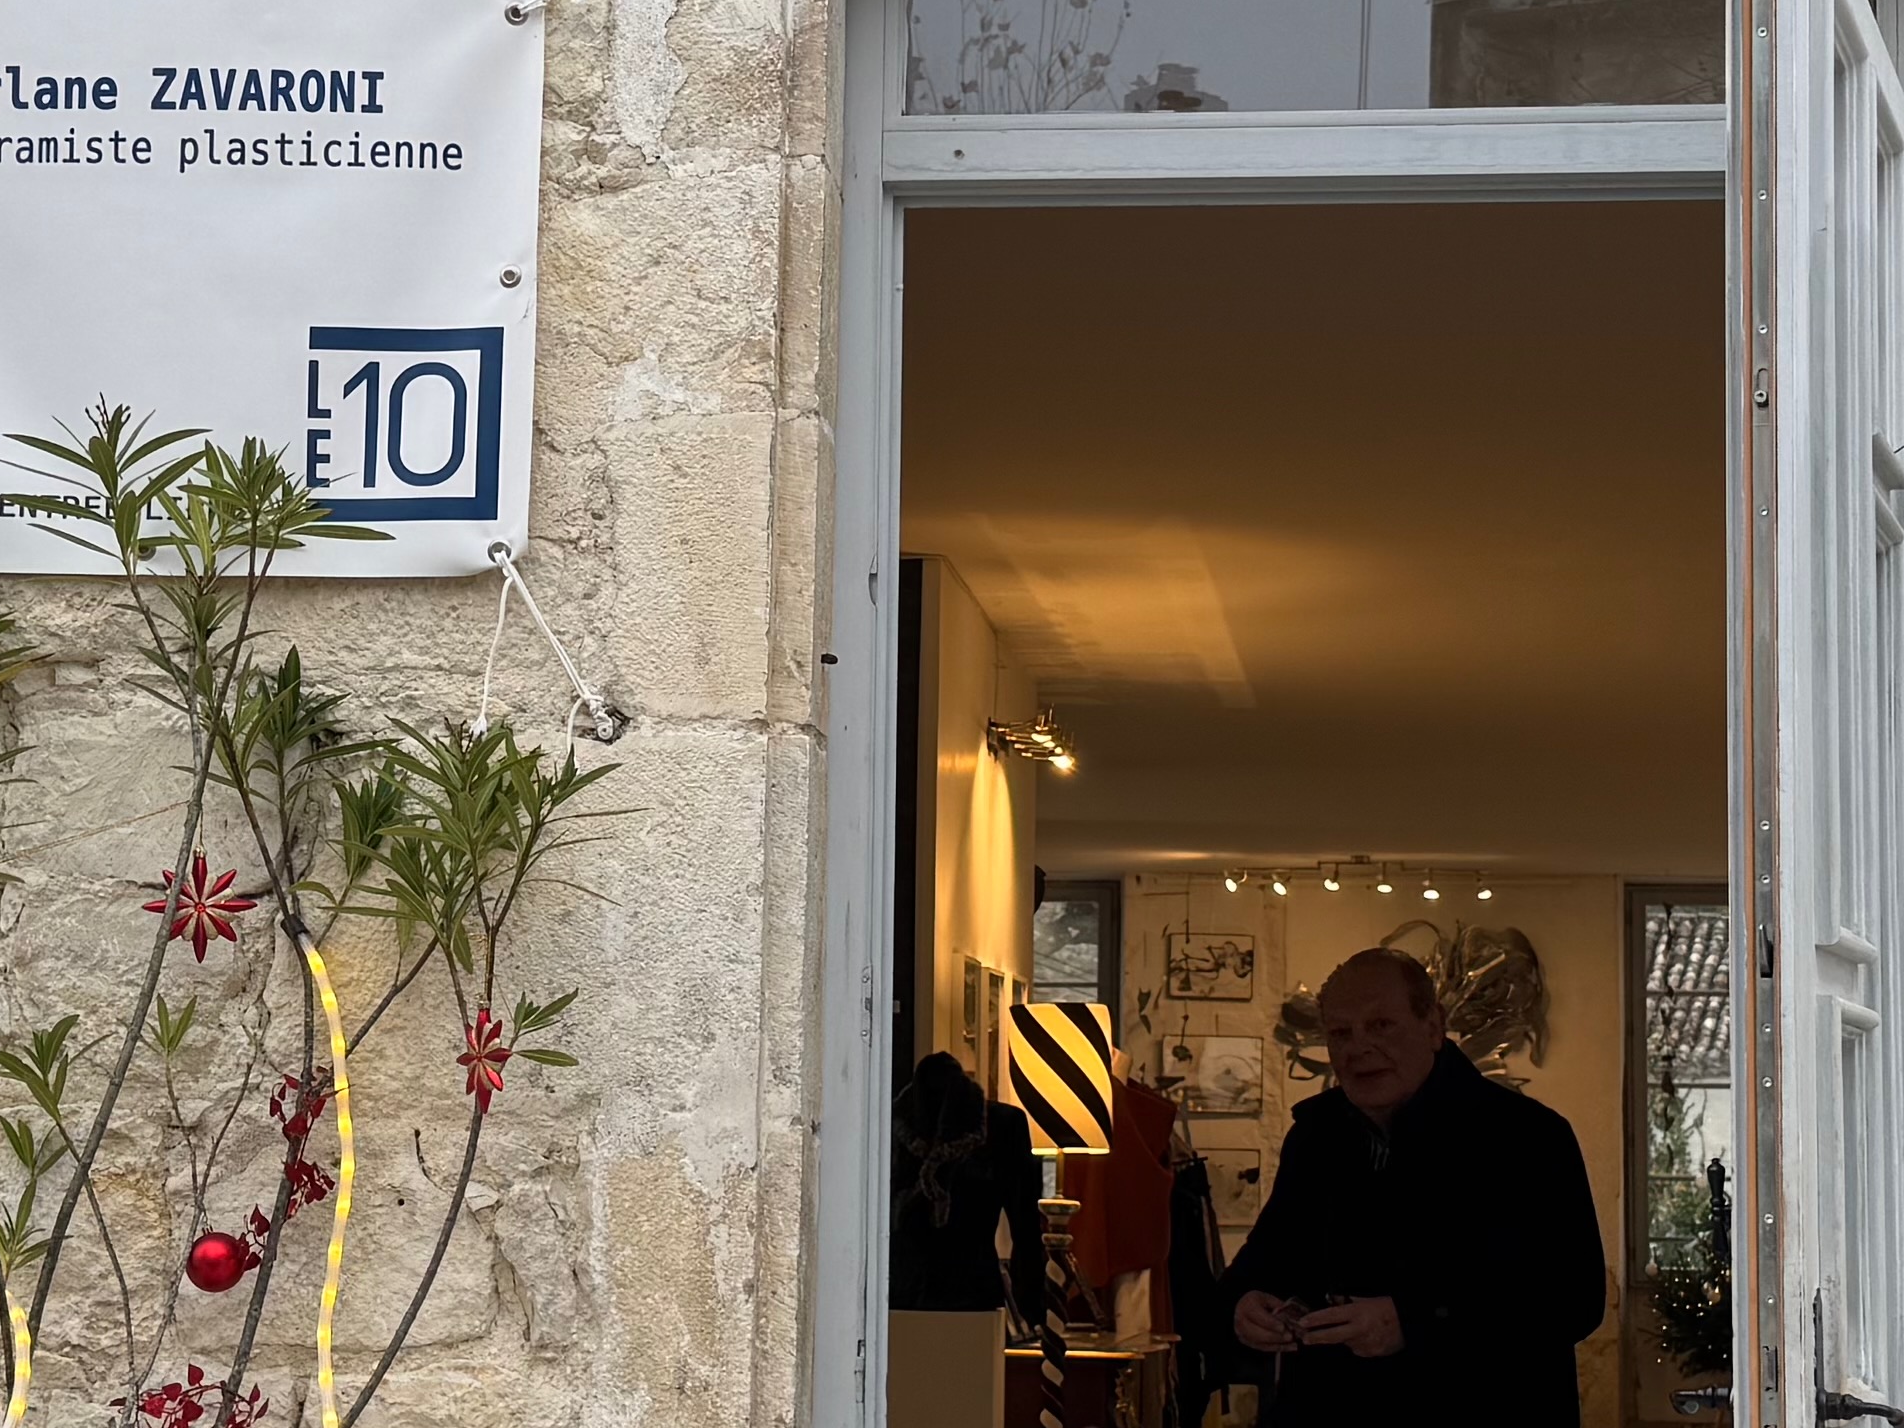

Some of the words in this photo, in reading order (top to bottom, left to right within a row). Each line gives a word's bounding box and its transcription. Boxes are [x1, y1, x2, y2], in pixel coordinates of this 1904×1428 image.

[150, 67, 385, 114] ZAVARONI
[179, 128, 463, 174] plasticienne
[338, 361, 468, 489] 10
